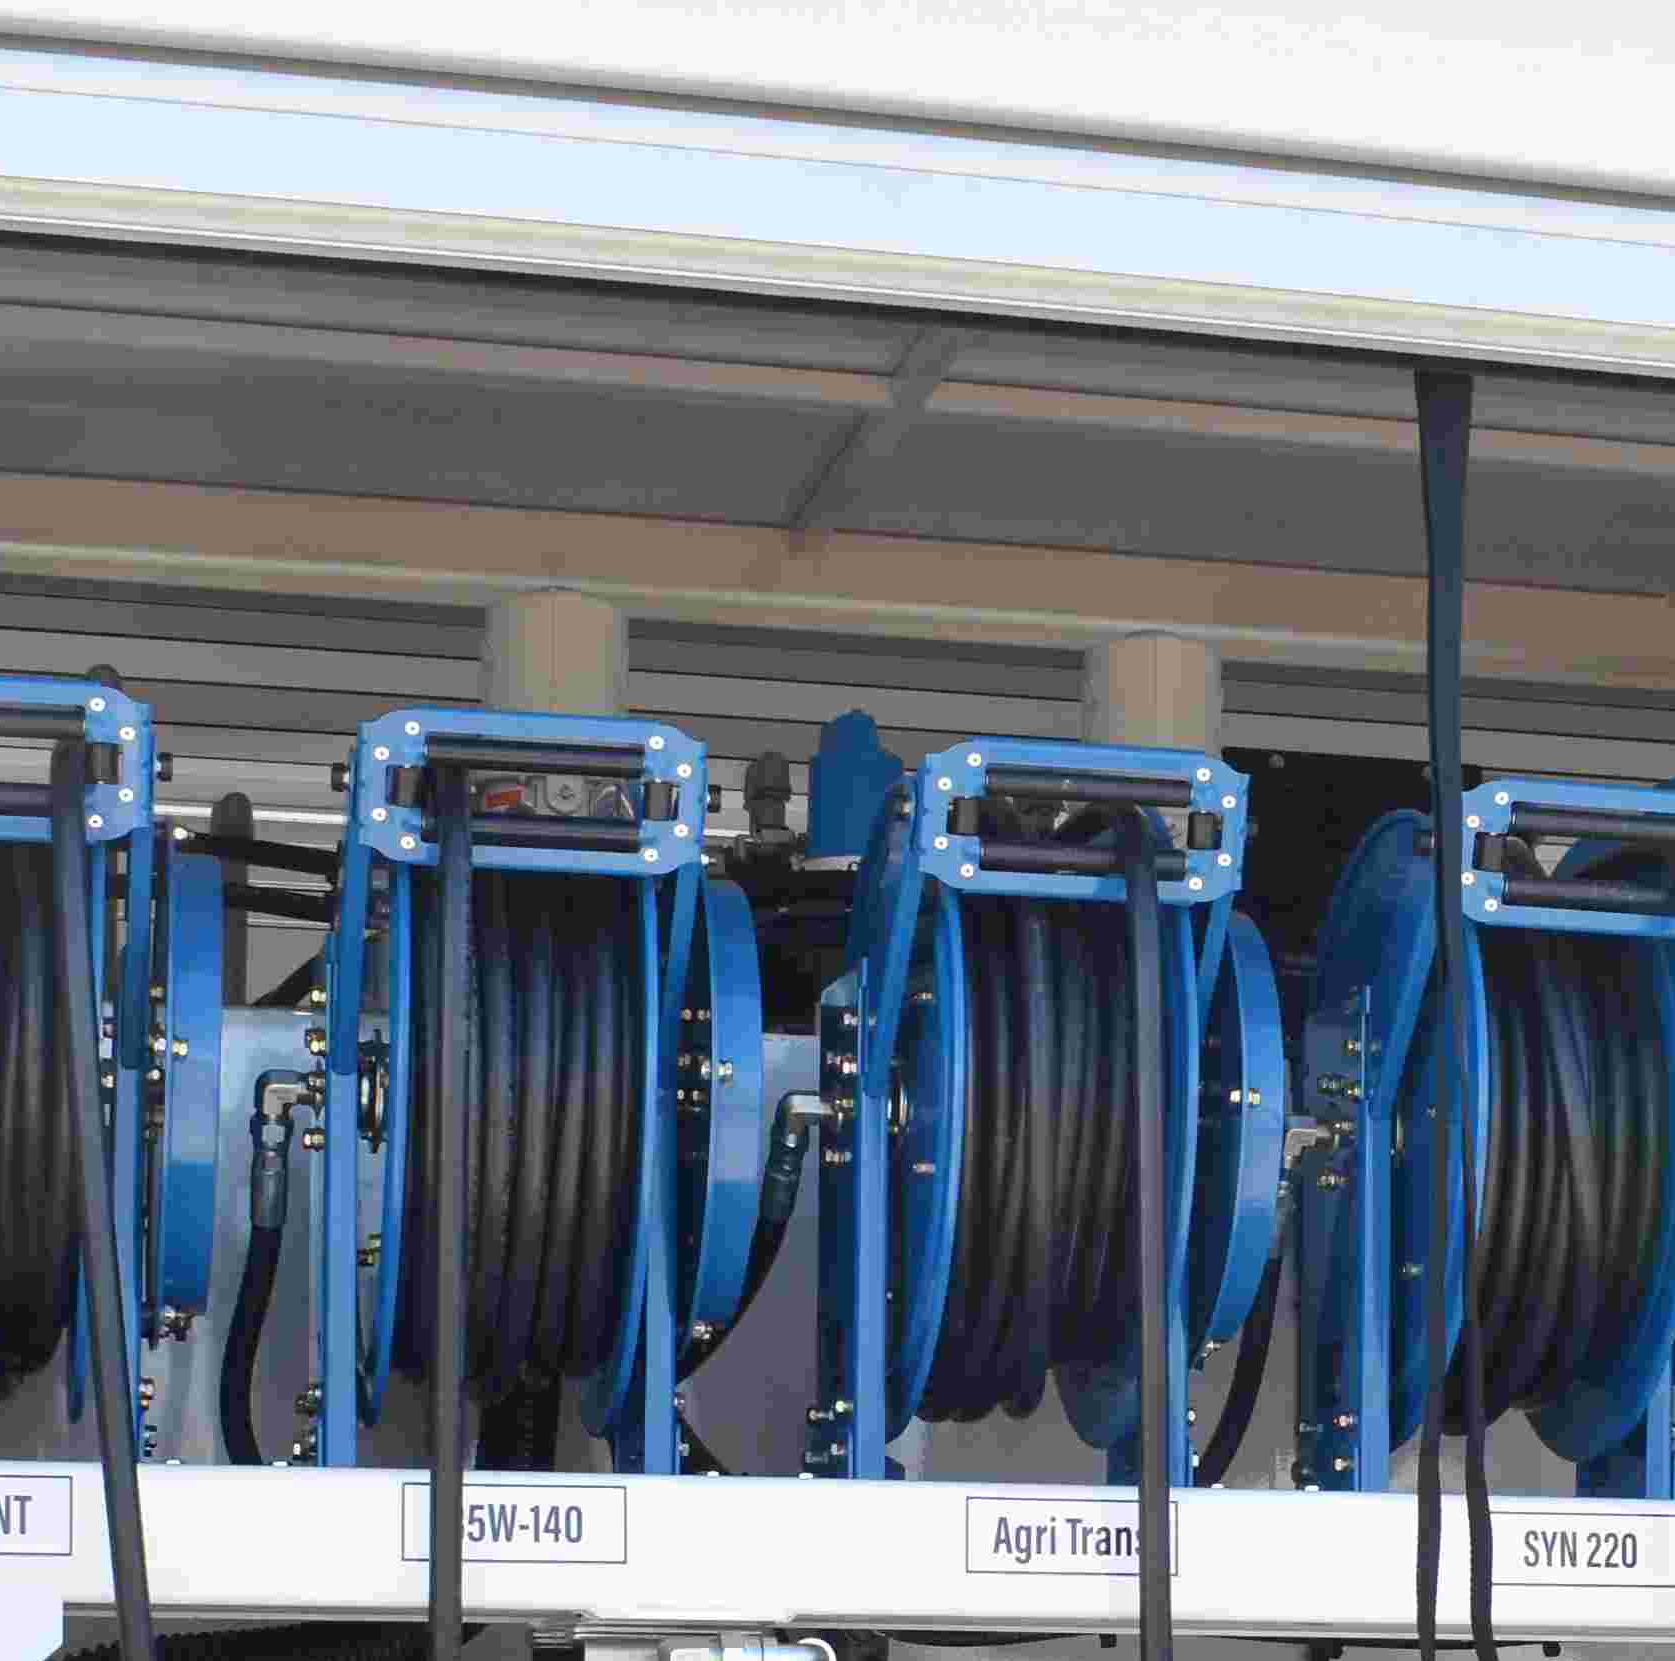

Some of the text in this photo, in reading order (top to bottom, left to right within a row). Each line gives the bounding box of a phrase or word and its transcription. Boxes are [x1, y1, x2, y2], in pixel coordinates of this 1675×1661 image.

[462, 1503, 583, 1543] 5W-140
[993, 1516, 1057, 1564] Agri
[1523, 1530, 1638, 1569] SYN 220
